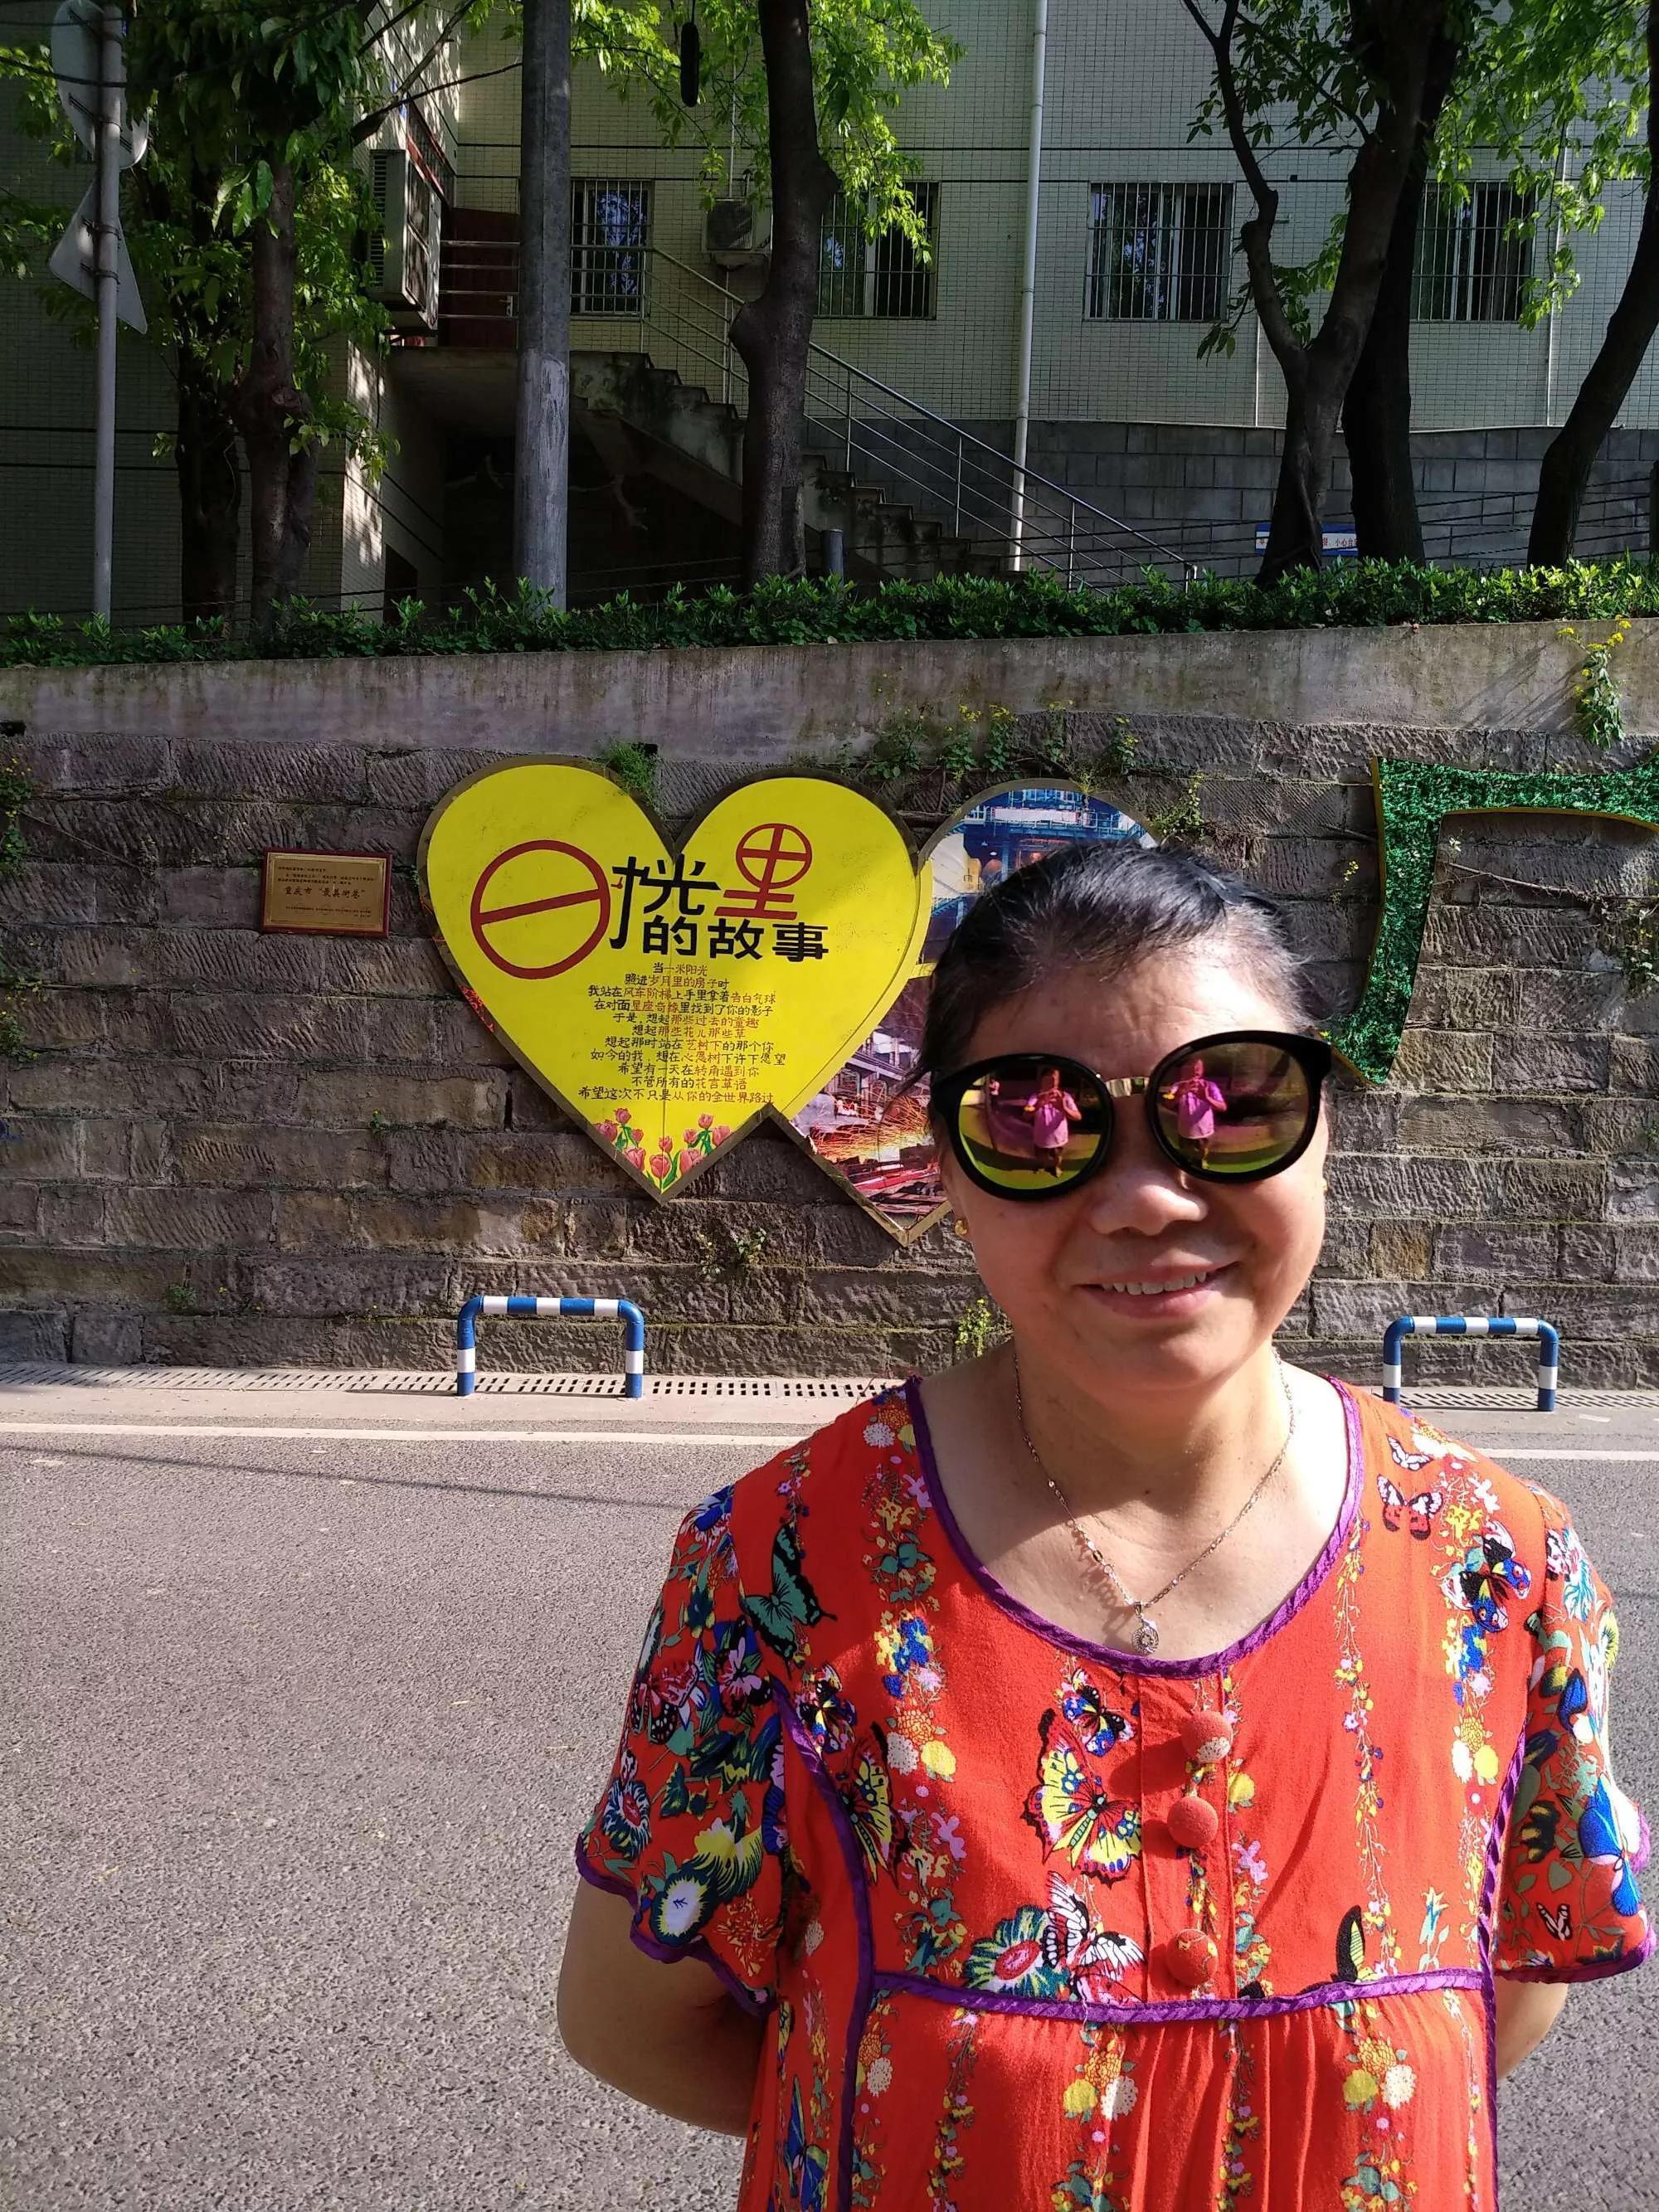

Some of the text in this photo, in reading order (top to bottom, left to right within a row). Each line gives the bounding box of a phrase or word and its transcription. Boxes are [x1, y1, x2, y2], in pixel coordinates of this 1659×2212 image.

[643, 915, 830, 963] 的故事
[653, 962, 708, 977] 当一米阳光
[624, 973, 730, 989] 照进岁月里的房子时
[594, 998, 773, 1017] 在对面星座奇缘里找到了你的影子
[632, 1024, 746, 1039] 想起那些花儿那些草
[618, 1062, 760, 1077] 希望有一天在转角遇到你
[578, 1086, 774, 1104] 希望这次不只是从你的全世界路过
